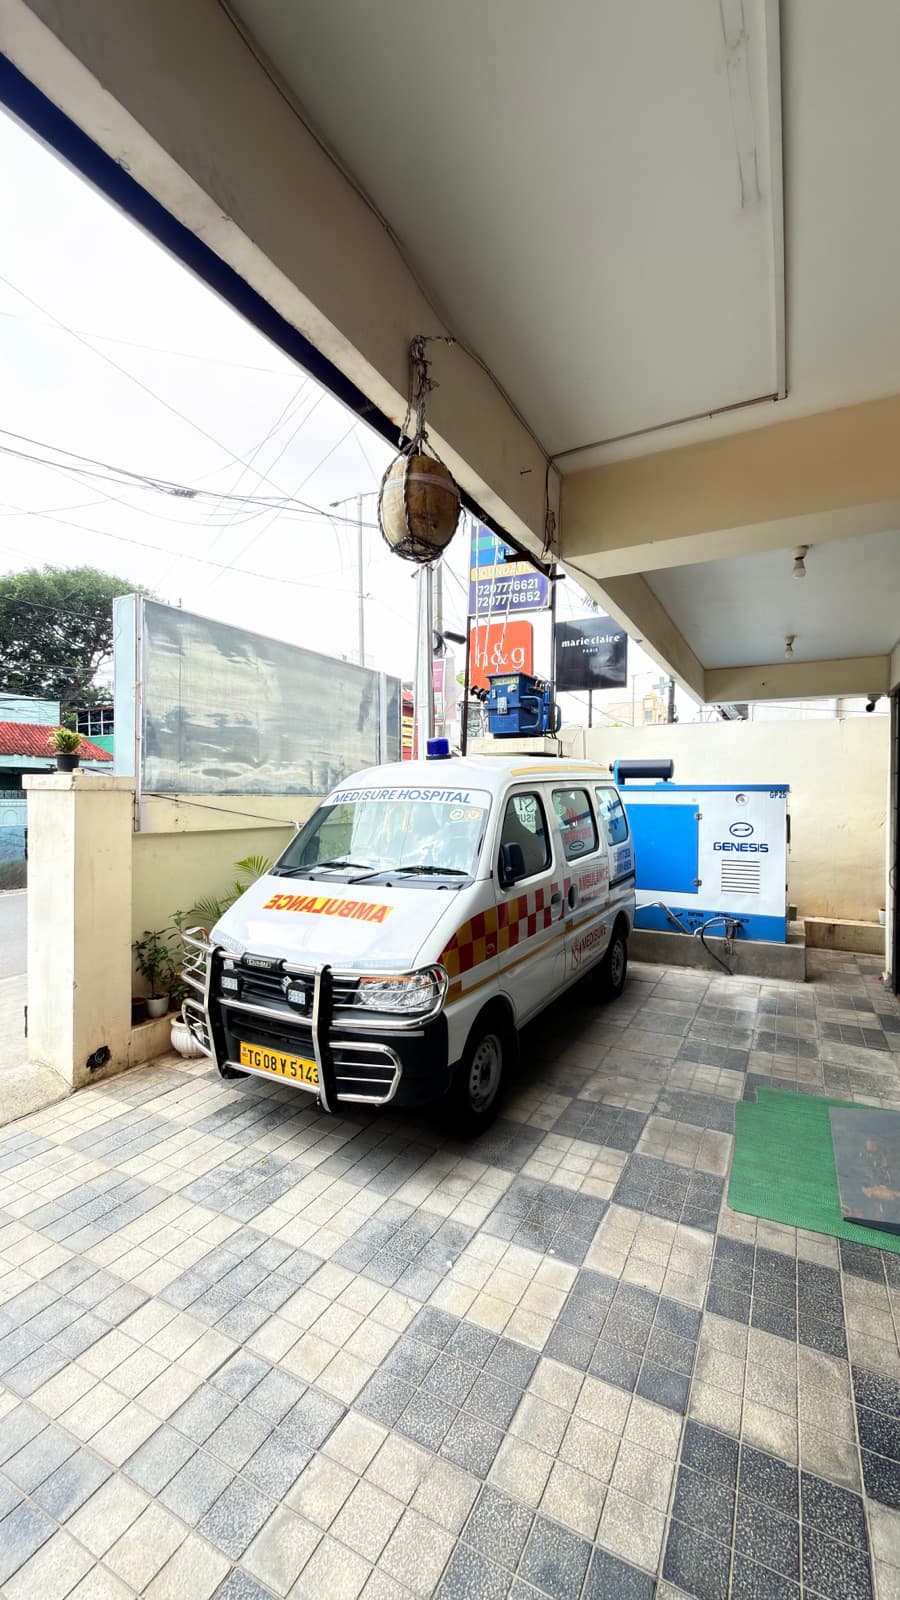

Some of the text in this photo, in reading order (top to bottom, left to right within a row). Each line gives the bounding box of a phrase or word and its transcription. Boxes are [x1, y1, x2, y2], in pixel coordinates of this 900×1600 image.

[561, 634, 621, 648] marie claire
[333, 789, 472, 804] MEDISURE HOSPITAL
[713, 841, 769, 853] GENESIS
[247, 1049, 261, 1067] TG
[263, 1054, 277, 1072] 08
[290, 1061, 320, 1084] 5143
